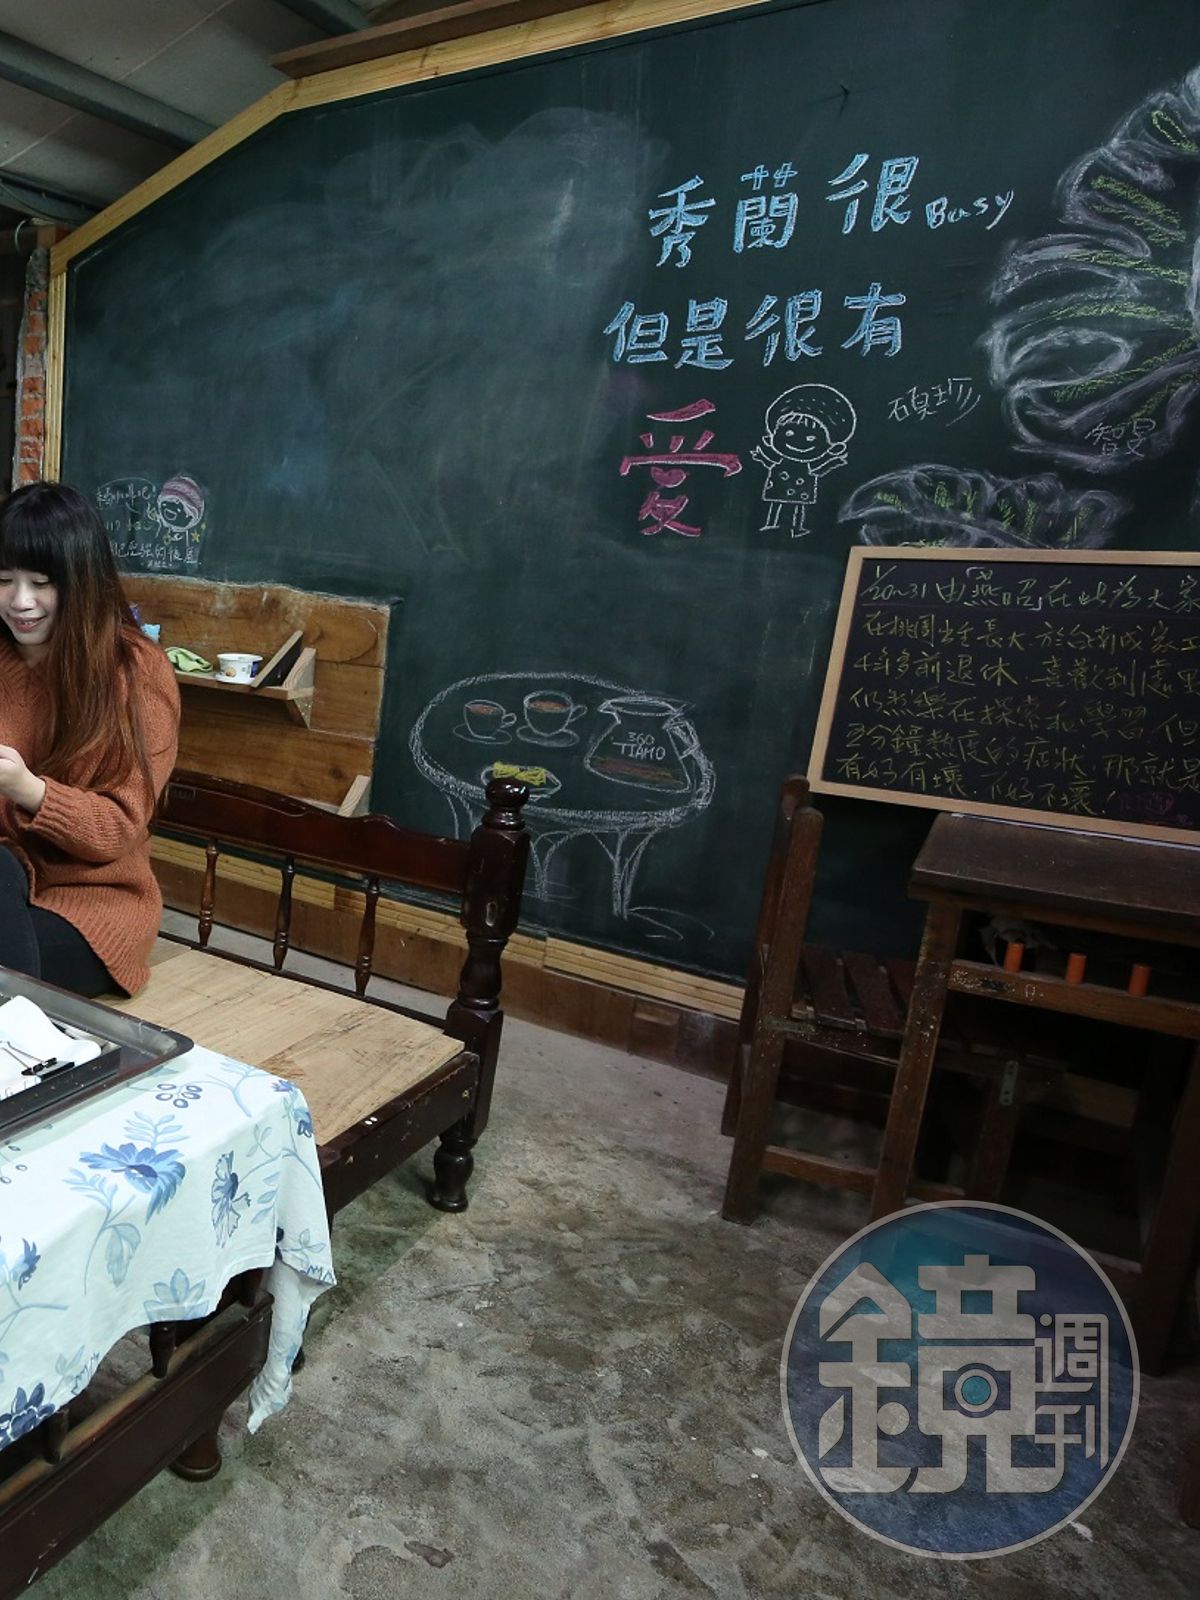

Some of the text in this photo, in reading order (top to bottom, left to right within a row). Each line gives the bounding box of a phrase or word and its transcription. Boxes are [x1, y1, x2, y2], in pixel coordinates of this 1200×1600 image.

[925, 190, 1015, 230] Busy
[603, 282, 906, 369] 但是很有
[612, 742, 666, 760] TIAMO
[628, 731, 656, 746] 360
